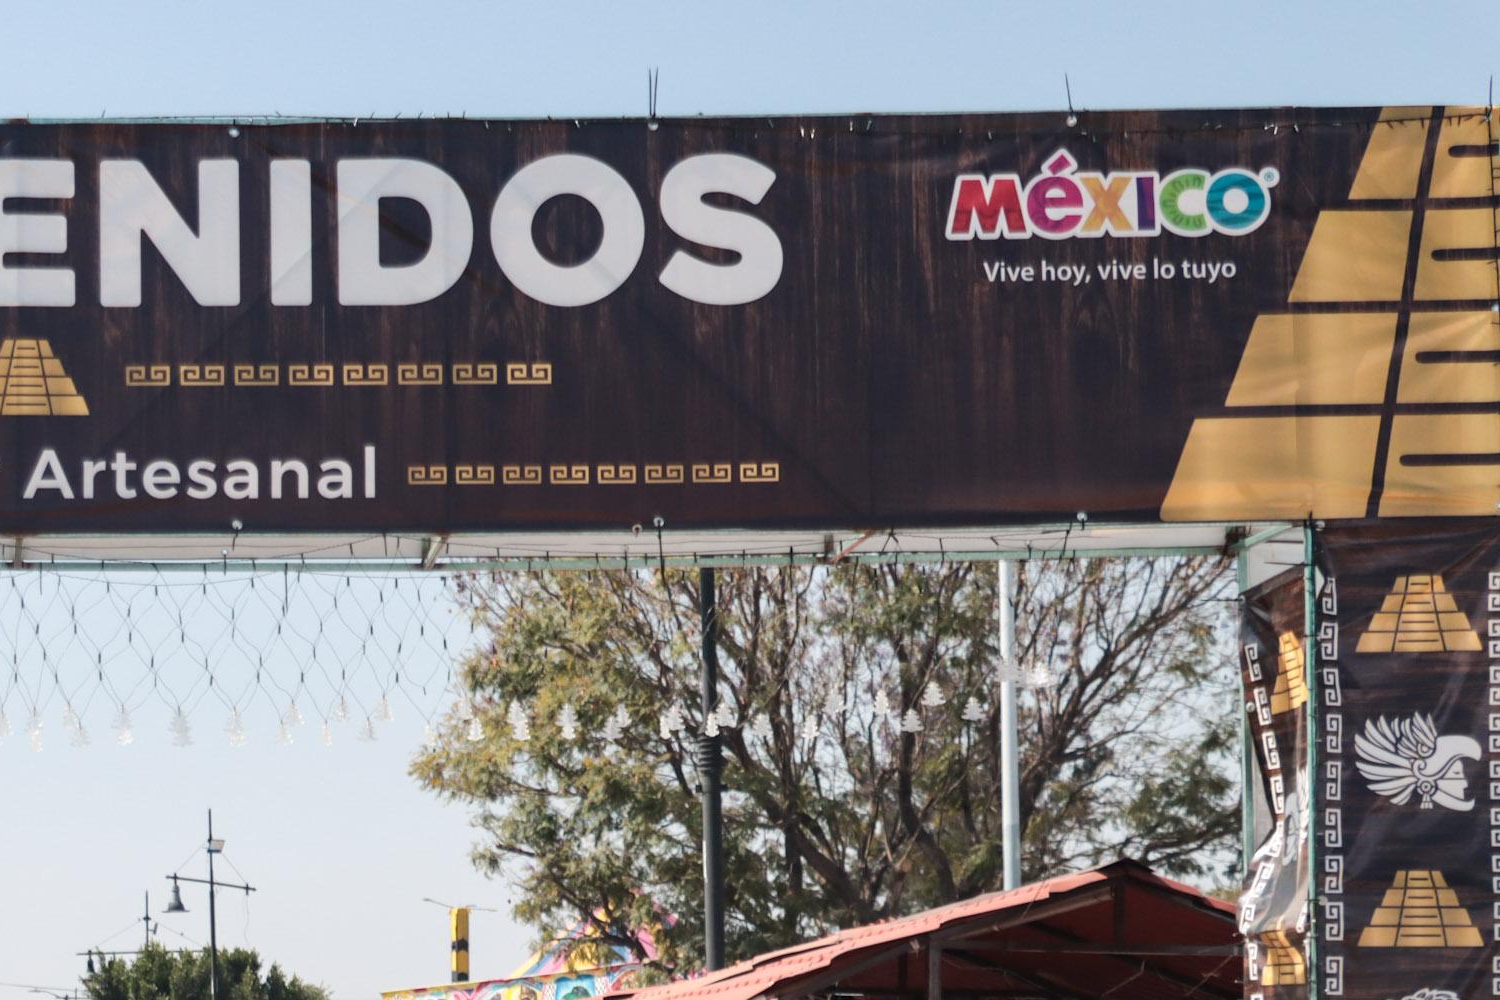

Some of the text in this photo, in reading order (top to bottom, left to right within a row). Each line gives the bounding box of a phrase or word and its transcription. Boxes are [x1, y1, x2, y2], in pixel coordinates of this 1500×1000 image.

[983, 257, 1237, 286] Vive hoy, vive lo tuyo
[22, 445, 378, 502] Artesanal
